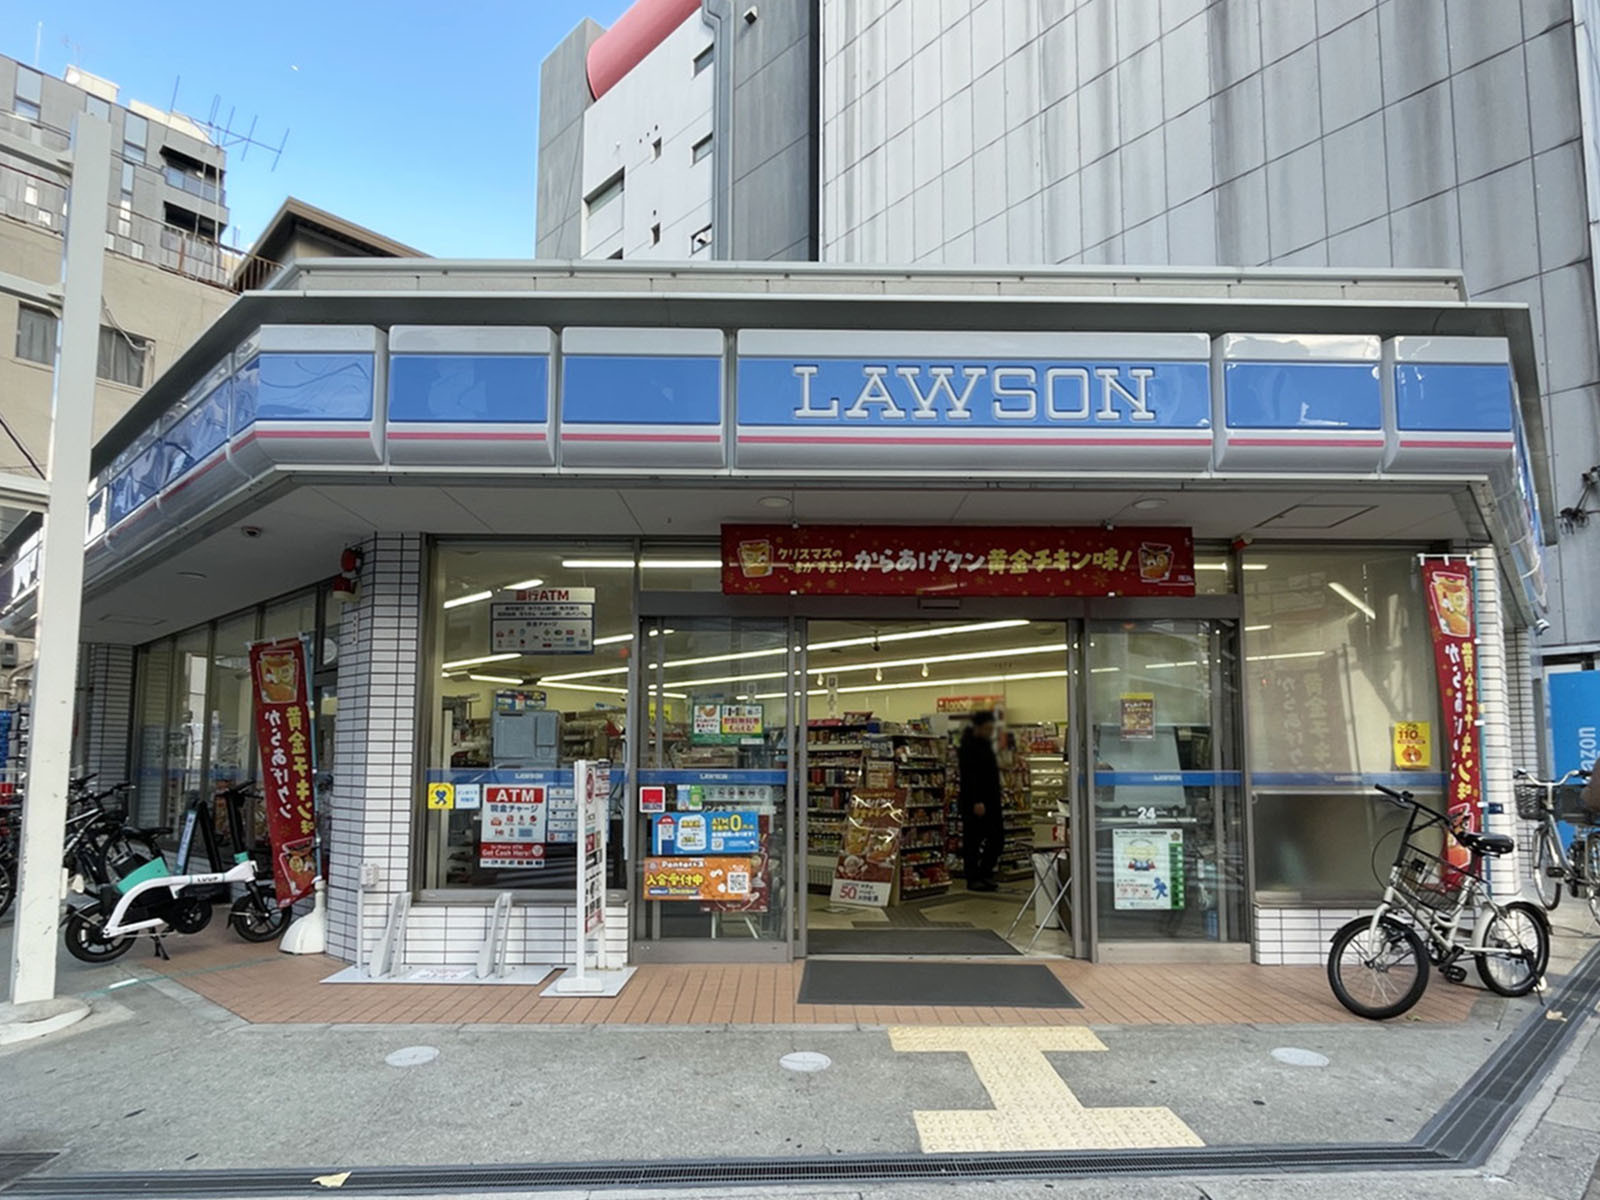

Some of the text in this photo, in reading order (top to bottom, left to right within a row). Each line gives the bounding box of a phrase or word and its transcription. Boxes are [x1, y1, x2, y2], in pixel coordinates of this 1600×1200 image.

[793, 364, 1157, 421] LAWSON
[777, 547, 843, 560] クリスマスの
[853, 547, 1133, 575] からあげクン黄金チキン味!
[496, 789, 535, 802] ATM
[1137, 806, 1157, 819] 24
[839, 885, 857, 899] 50
